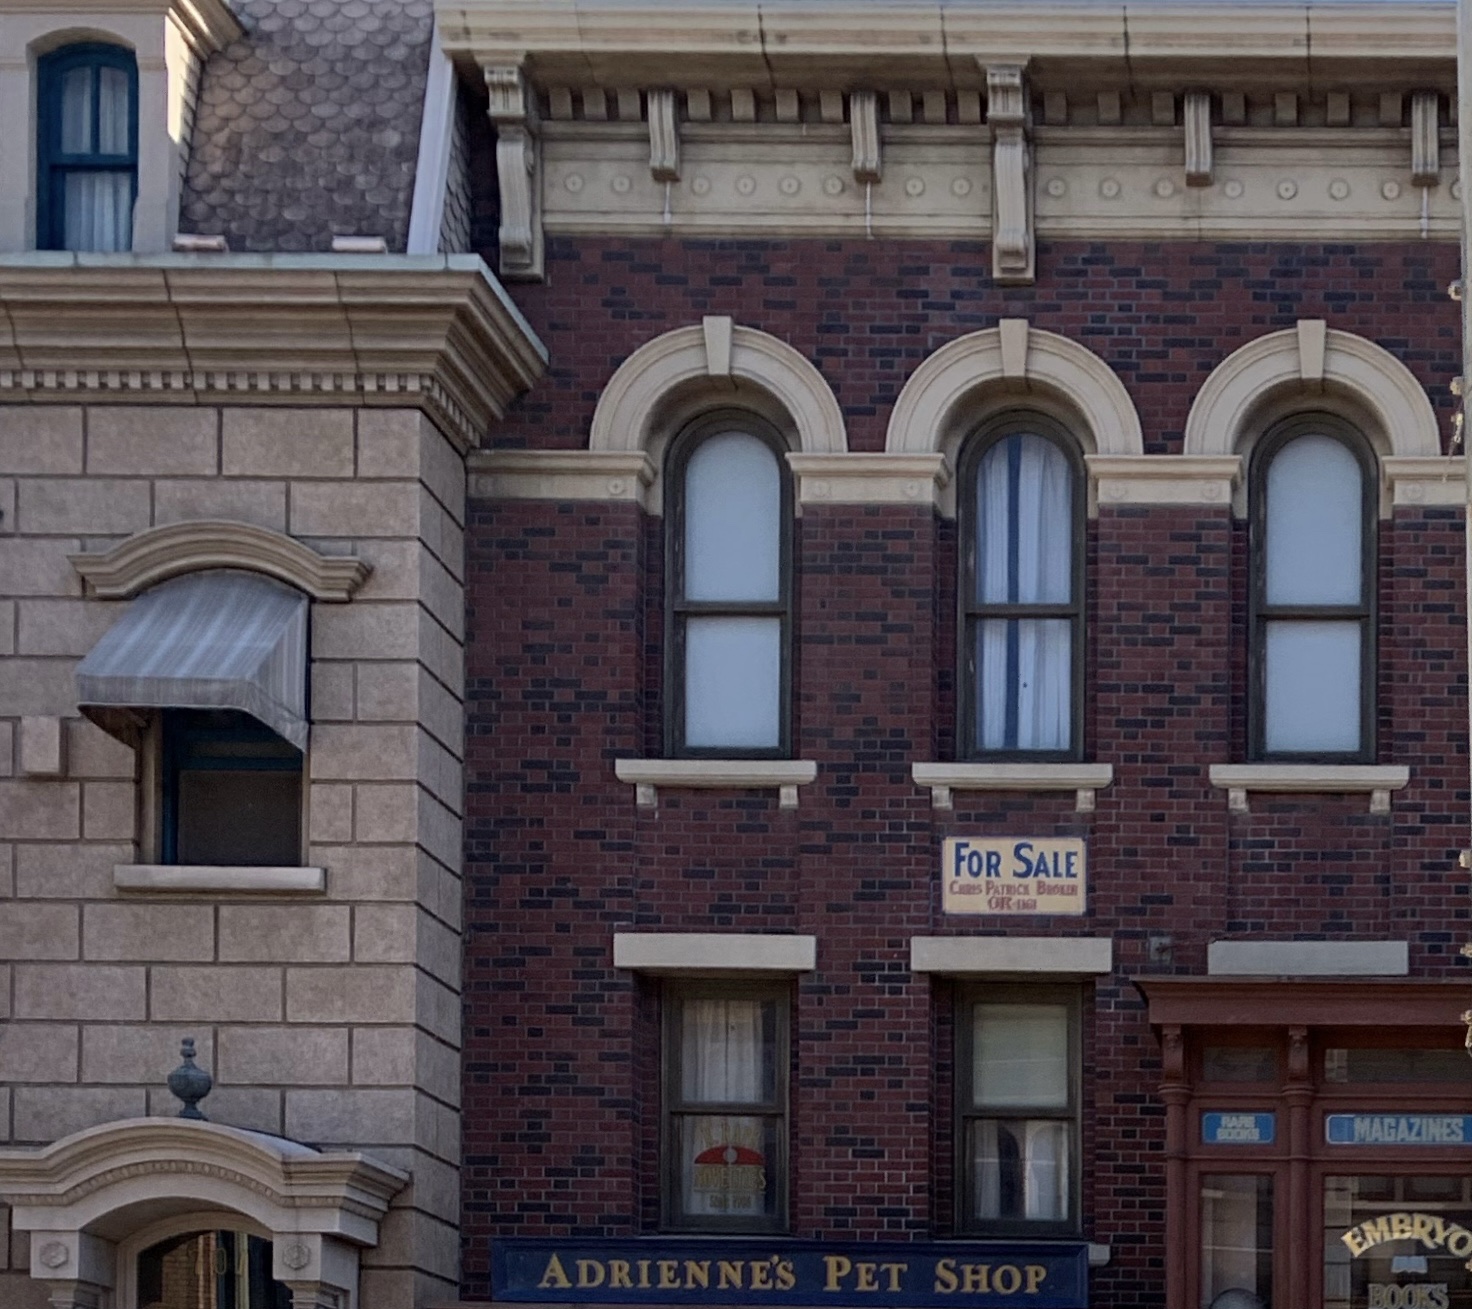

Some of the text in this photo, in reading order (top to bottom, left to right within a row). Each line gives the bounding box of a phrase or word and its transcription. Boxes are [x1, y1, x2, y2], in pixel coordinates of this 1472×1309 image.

[954, 842, 1078, 878] FOR SALE
[1353, 1117, 1464, 1142] MAGAZINES
[537, 1252, 1047, 1294] ADRIENNE'S PET SHOP
